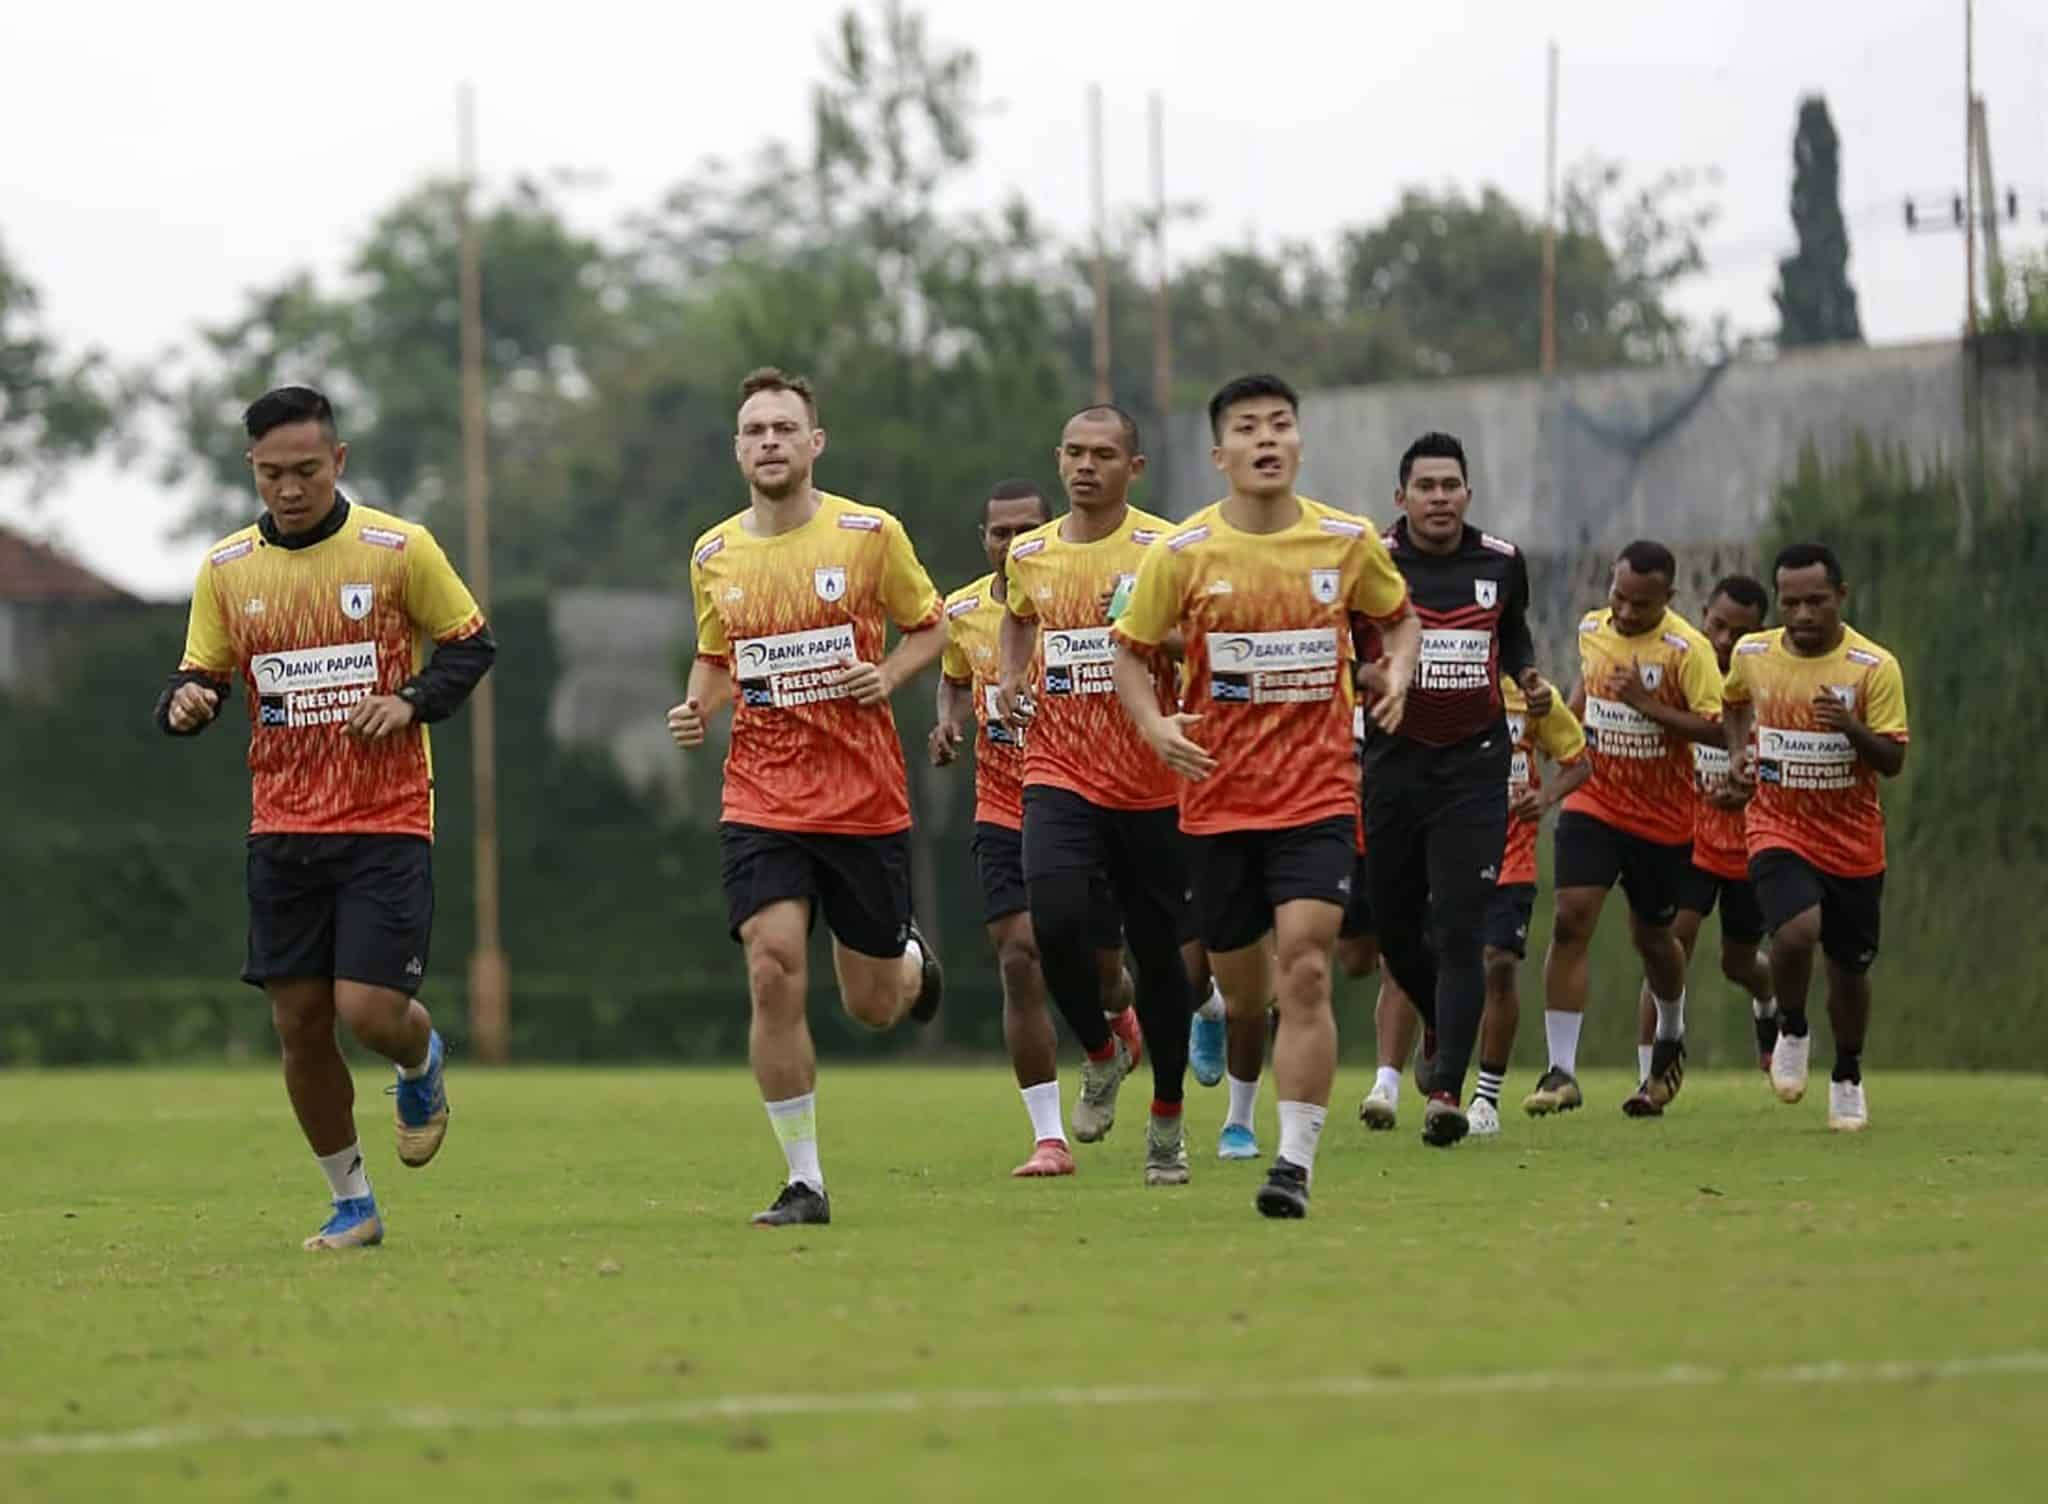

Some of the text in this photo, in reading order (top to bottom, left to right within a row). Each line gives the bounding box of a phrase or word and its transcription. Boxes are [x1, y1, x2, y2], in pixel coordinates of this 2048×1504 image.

[768, 636, 851, 660] BANK PAPUA
[1072, 639, 1105, 652] BANK
[1255, 643, 1296, 657] BANK
[1423, 639, 1457, 650] BANK
[286, 654, 373, 677] BANK PAPUA
